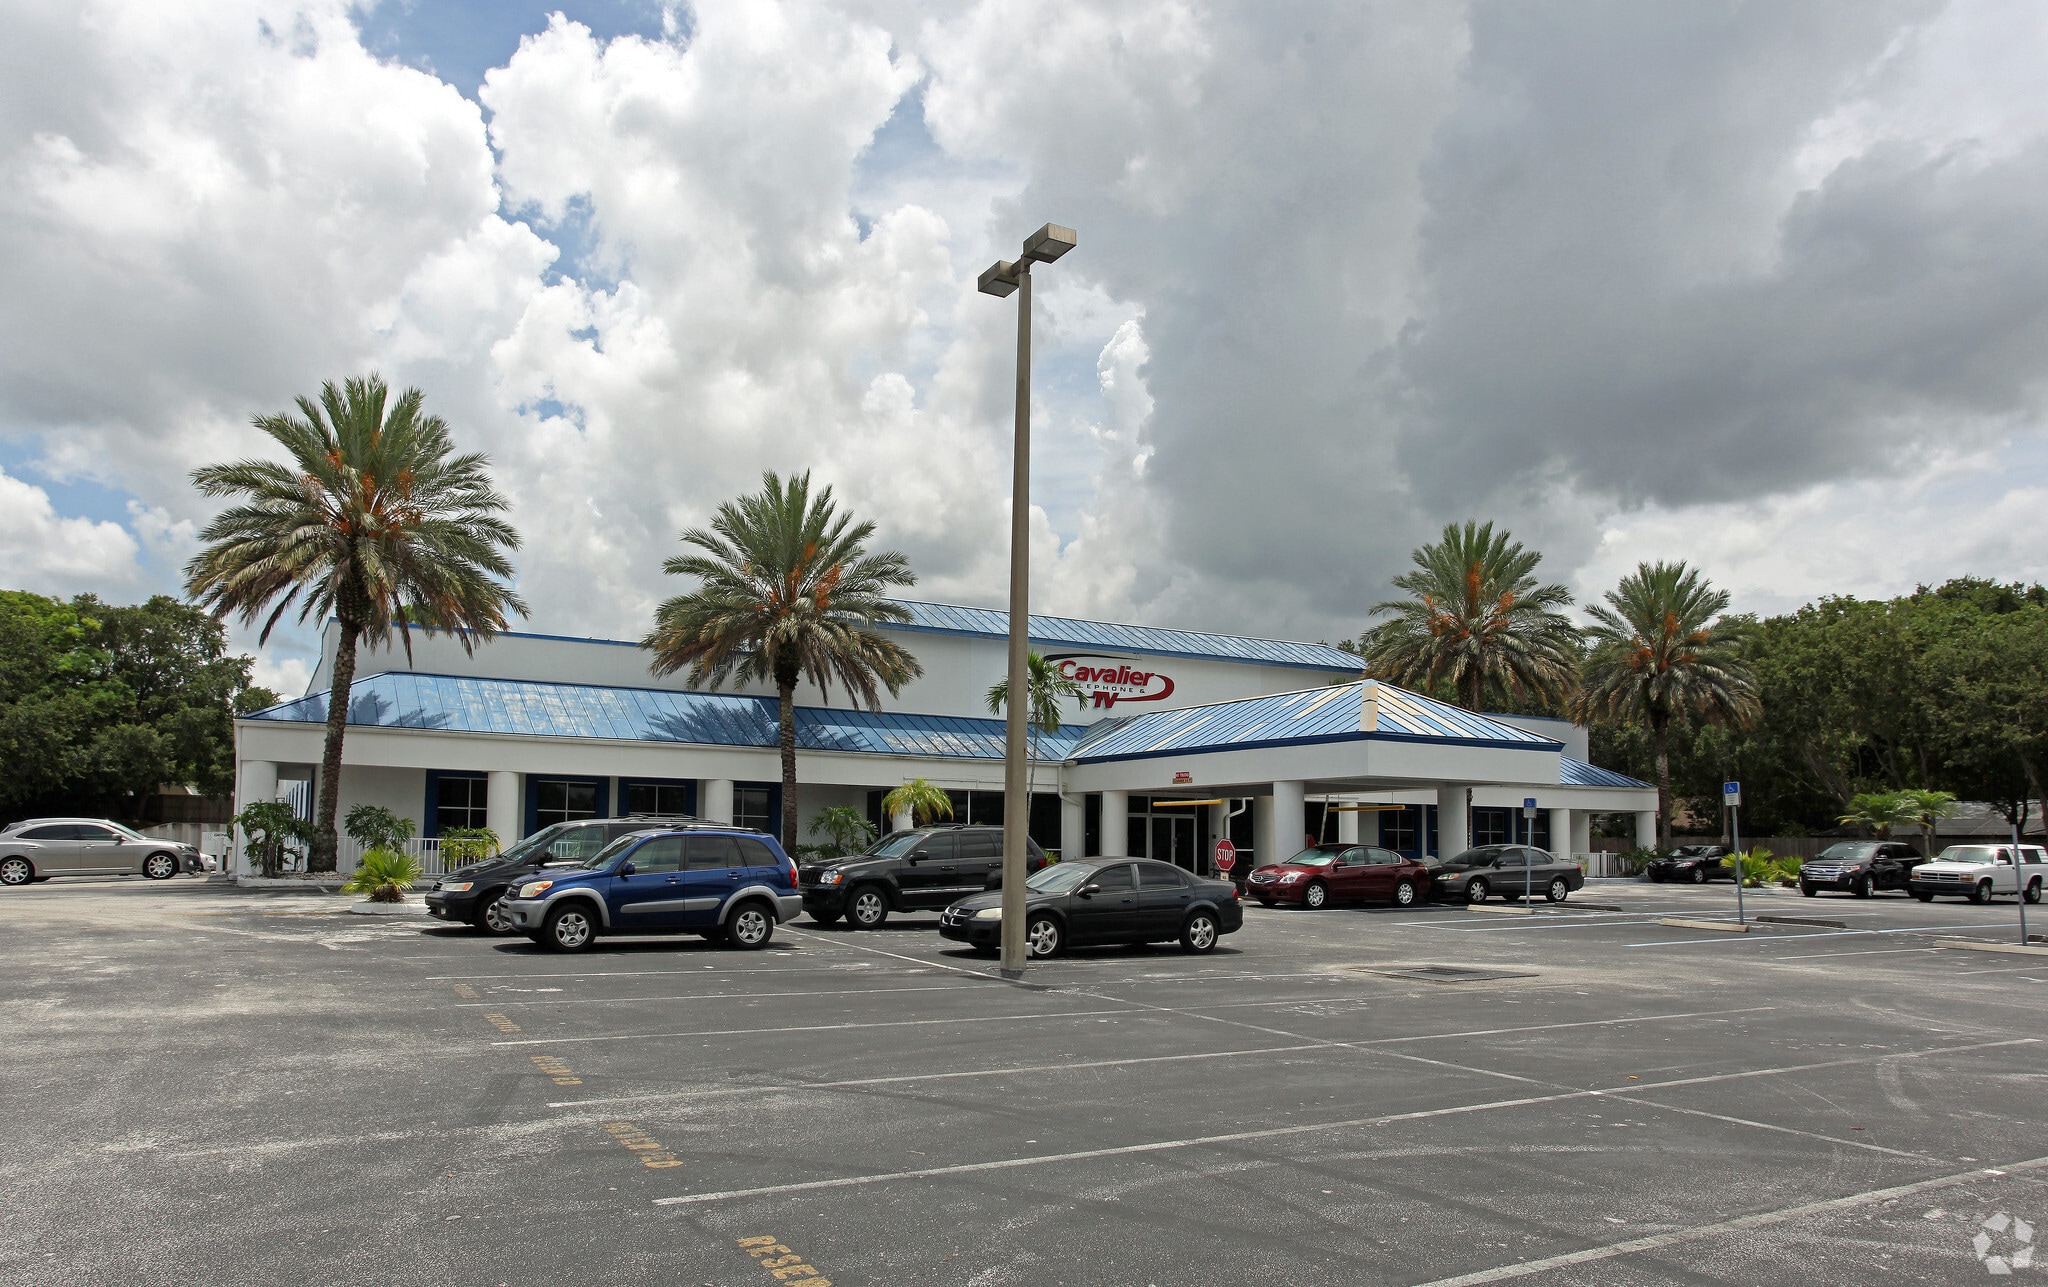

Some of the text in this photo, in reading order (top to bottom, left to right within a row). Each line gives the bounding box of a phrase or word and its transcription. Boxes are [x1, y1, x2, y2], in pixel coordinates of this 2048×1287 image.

[1059, 660, 1155, 687] Cavalier
[1076, 683, 1134, 693] LEPHONE
[1092, 691, 1119, 708] TV
[1217, 848, 1233, 861] STOP
